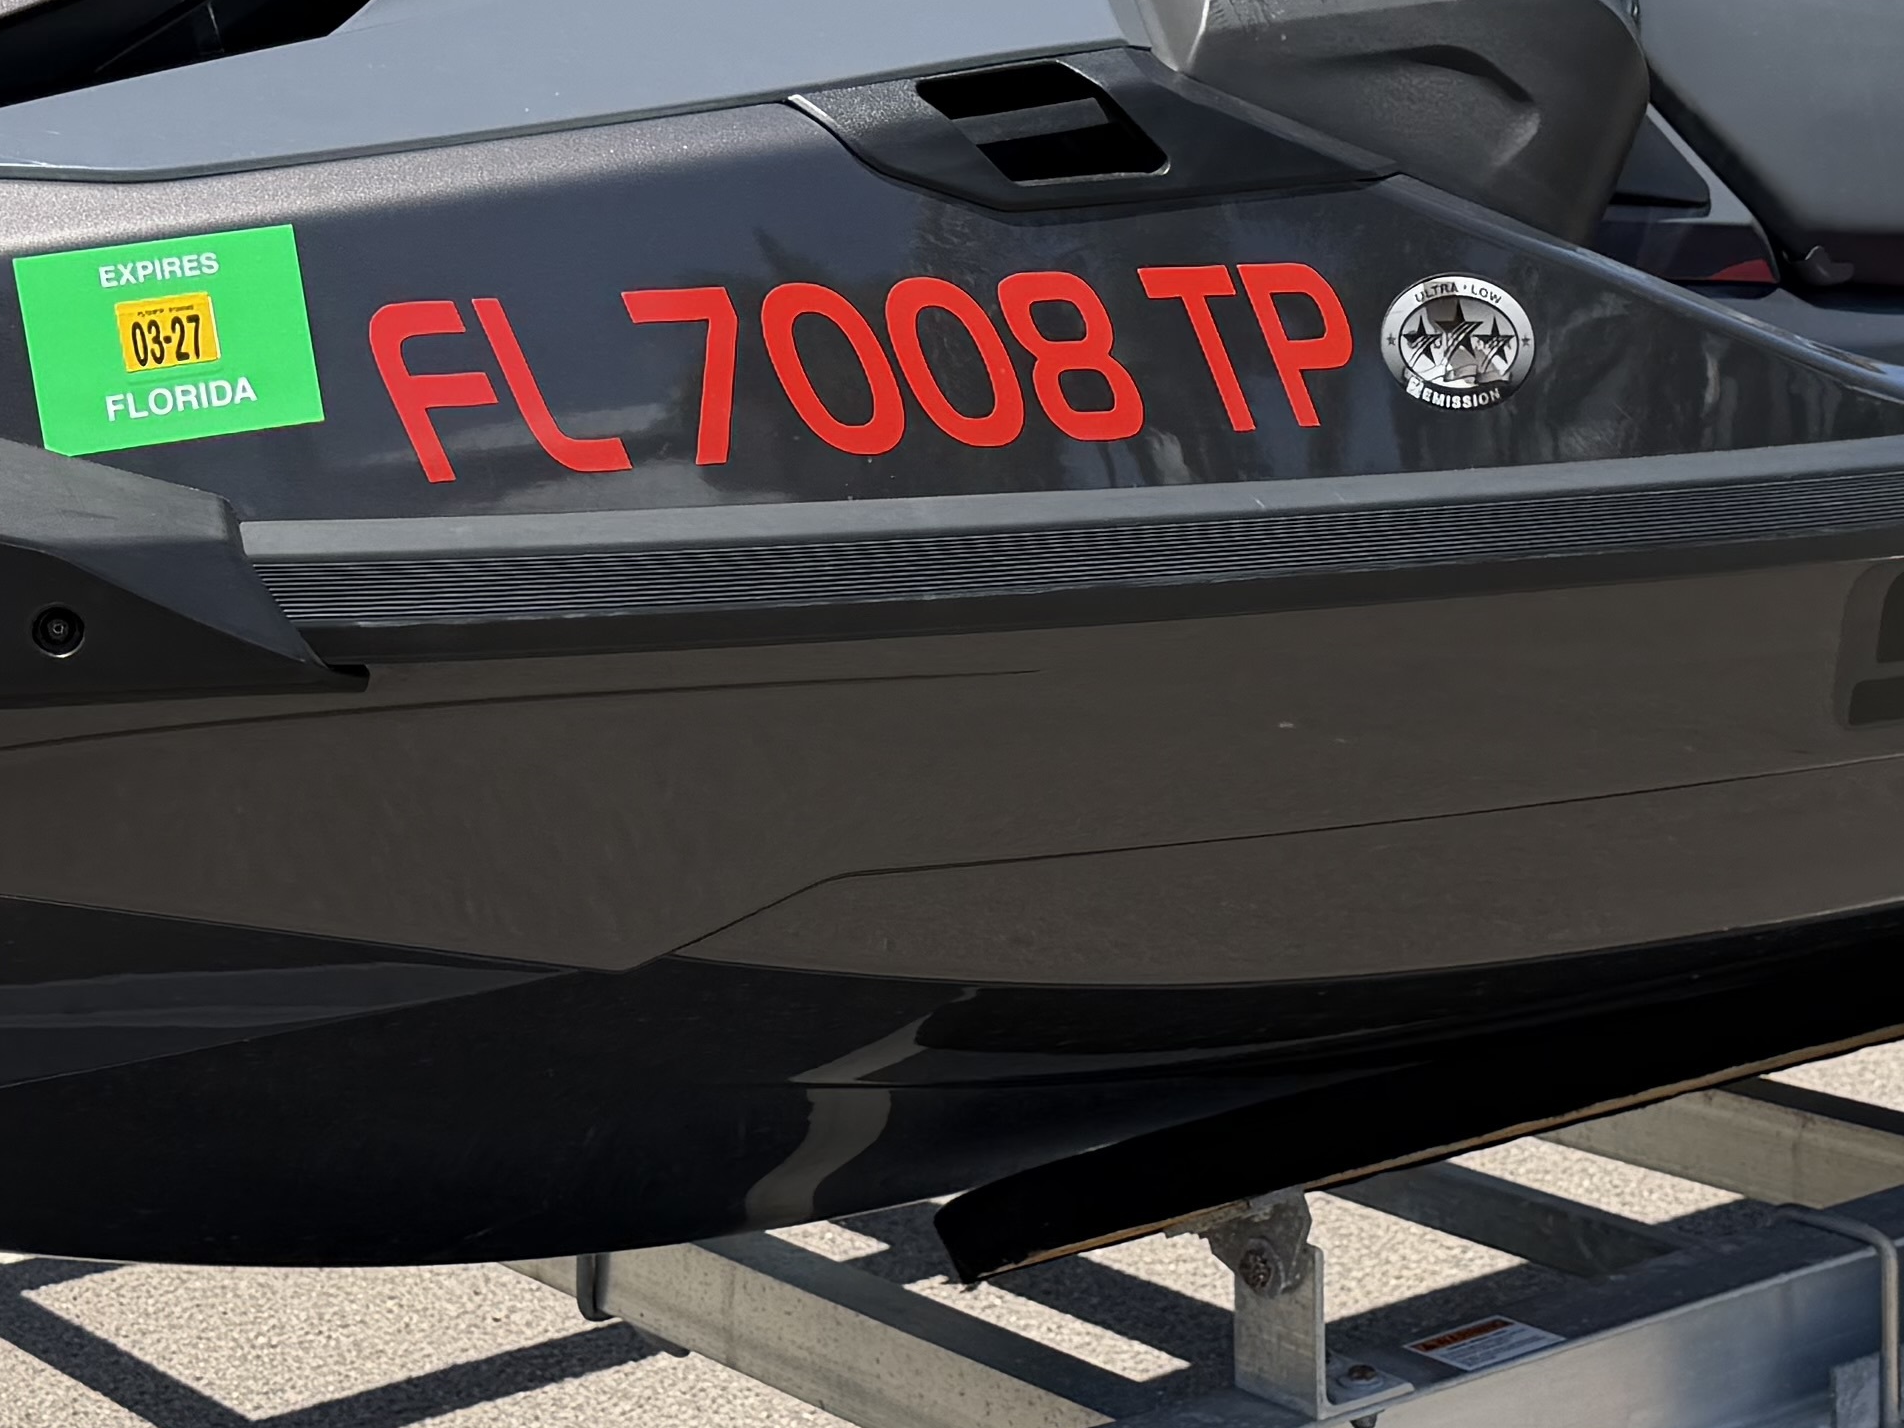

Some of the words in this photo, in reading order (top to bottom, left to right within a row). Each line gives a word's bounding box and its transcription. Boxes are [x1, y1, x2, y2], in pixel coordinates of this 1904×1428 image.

[99, 252, 220, 289] EXPIRES
[132, 314, 200, 367] 03-27
[370, 298, 633, 483] FL
[621, 270, 1144, 465] 7008
[1137, 262, 1353, 431] TP
[105, 377, 257, 422] FLORIDA
[1422, 387, 1501, 409] EMISSION
